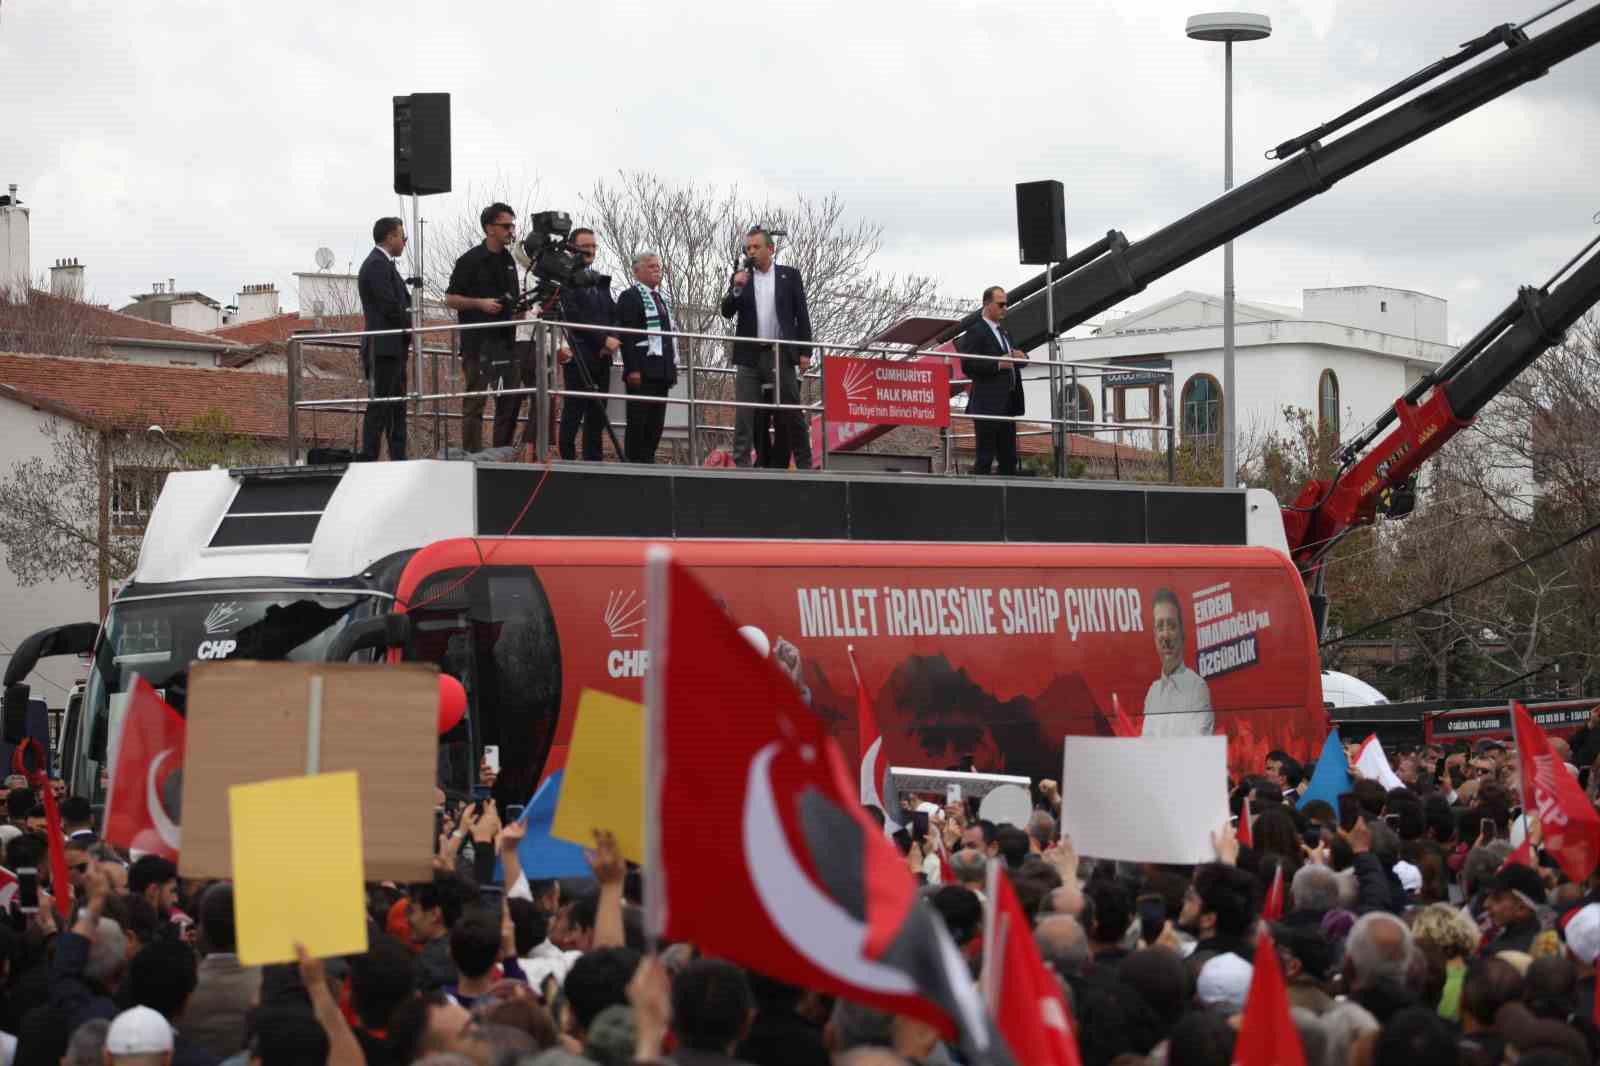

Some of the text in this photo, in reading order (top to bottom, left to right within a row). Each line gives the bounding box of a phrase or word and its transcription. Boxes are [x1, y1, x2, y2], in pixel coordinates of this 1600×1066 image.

[875, 367, 933, 384] CUMHURİYET
[876, 388, 935, 403] HALK PARTİSİ
[1064, 587, 1144, 641] ÇIKIYOR
[197, 640, 237, 660] CHP
